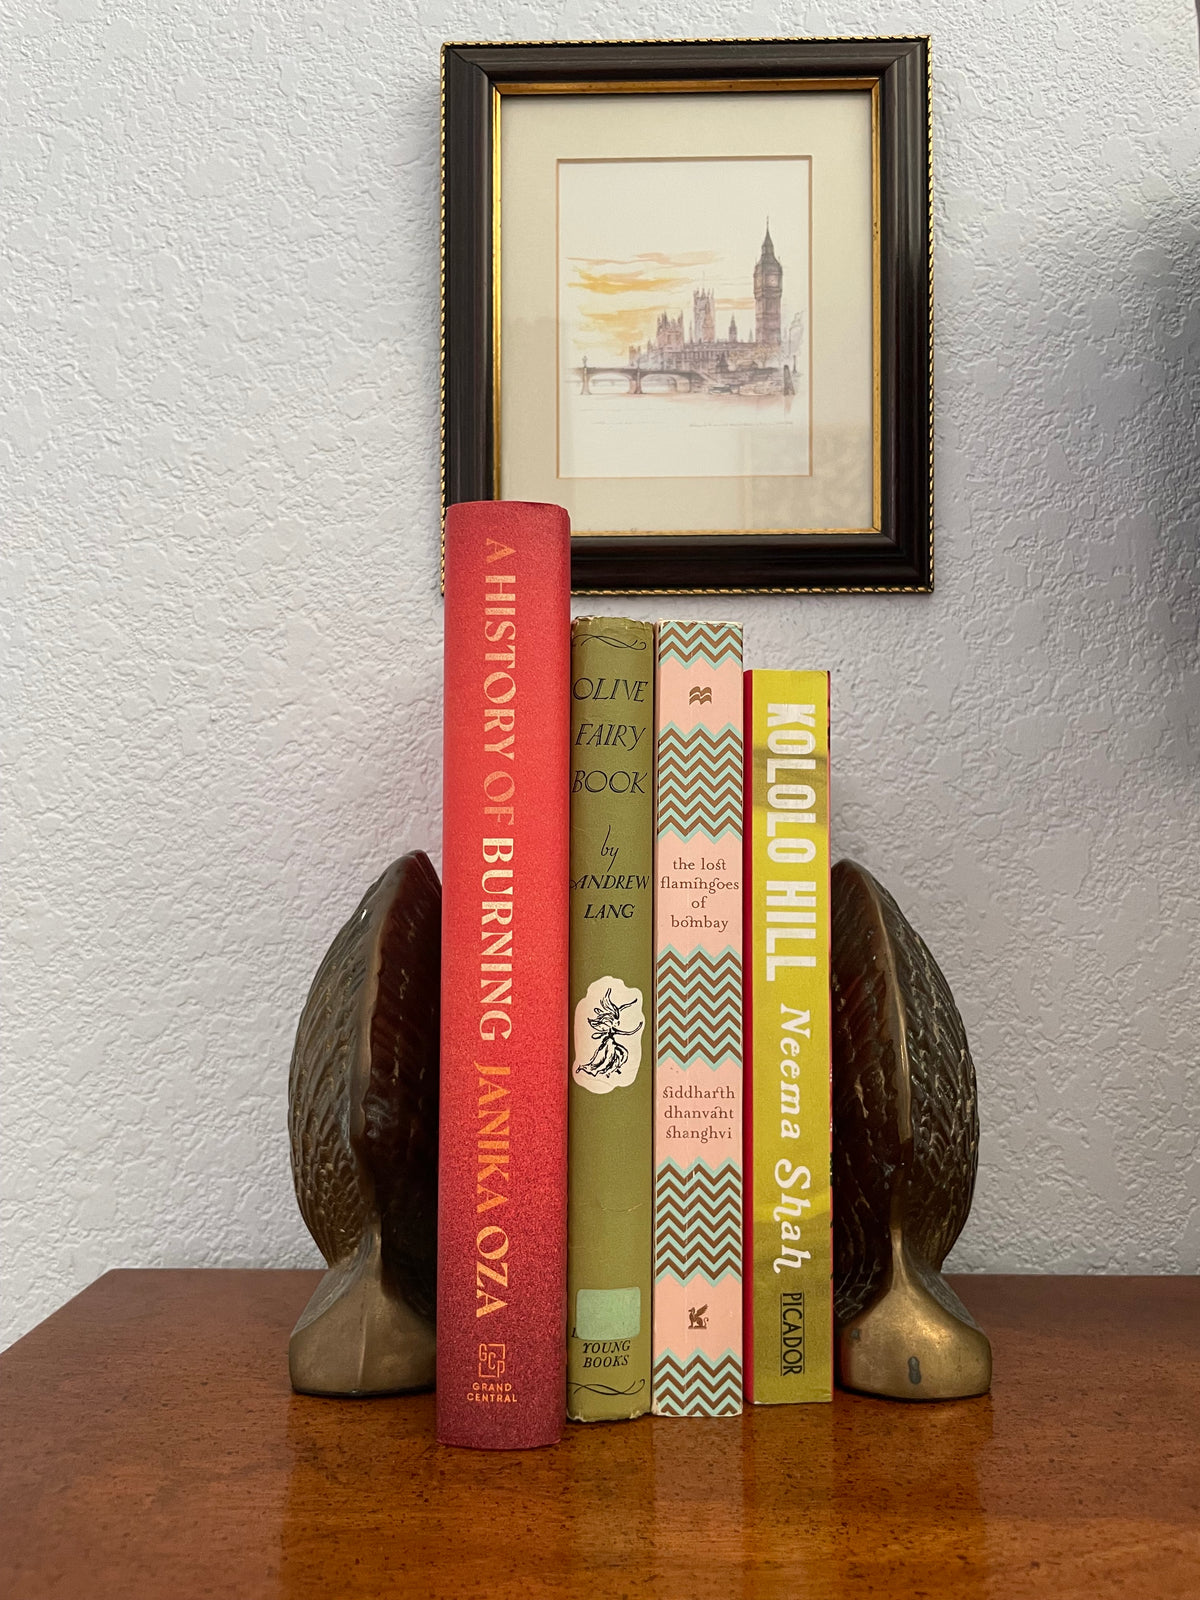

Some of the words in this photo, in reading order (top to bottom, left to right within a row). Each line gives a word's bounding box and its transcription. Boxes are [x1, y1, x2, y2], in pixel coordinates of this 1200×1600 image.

[485, 537, 517, 564] A
[483, 574, 516, 761] HISTORY
[573, 677, 648, 703] OLIVE
[575, 723, 646, 751] FAIRY
[572, 770, 648, 794] BOOK
[766, 703, 816, 864] KOLOLO
[482, 770, 515, 826] OF
[600, 824, 619, 872] by
[673, 857, 695, 870] the
[701, 857, 727, 870] lost
[570, 874, 650, 890] ANDREW
[660, 876, 739, 894] flamingoes
[584, 903, 635, 919] LANG
[691, 895, 708, 909] of
[671, 914, 729, 933] bombay
[766, 879, 817, 982] HILL
[480, 837, 514, 1041] BURNING
[780, 1003, 811, 1139] Neema
[662, 1085, 735, 1099] siddharth
[664, 1105, 734, 1119] dhanvant
[474, 1060, 511, 1213] JANIKA
[665, 1125, 732, 1144] shanghvi
[774, 1158, 811, 1274] Shah
[475, 1225, 509, 1318] OZA
[781, 1292, 804, 1376] PICADOR
[582, 1340, 631, 1354] YOUNG
[582, 1354, 630, 1368] BOOKS
[467, 1392, 517, 1403] CENTRAL
[472, 1382, 512, 1392] GRAND
